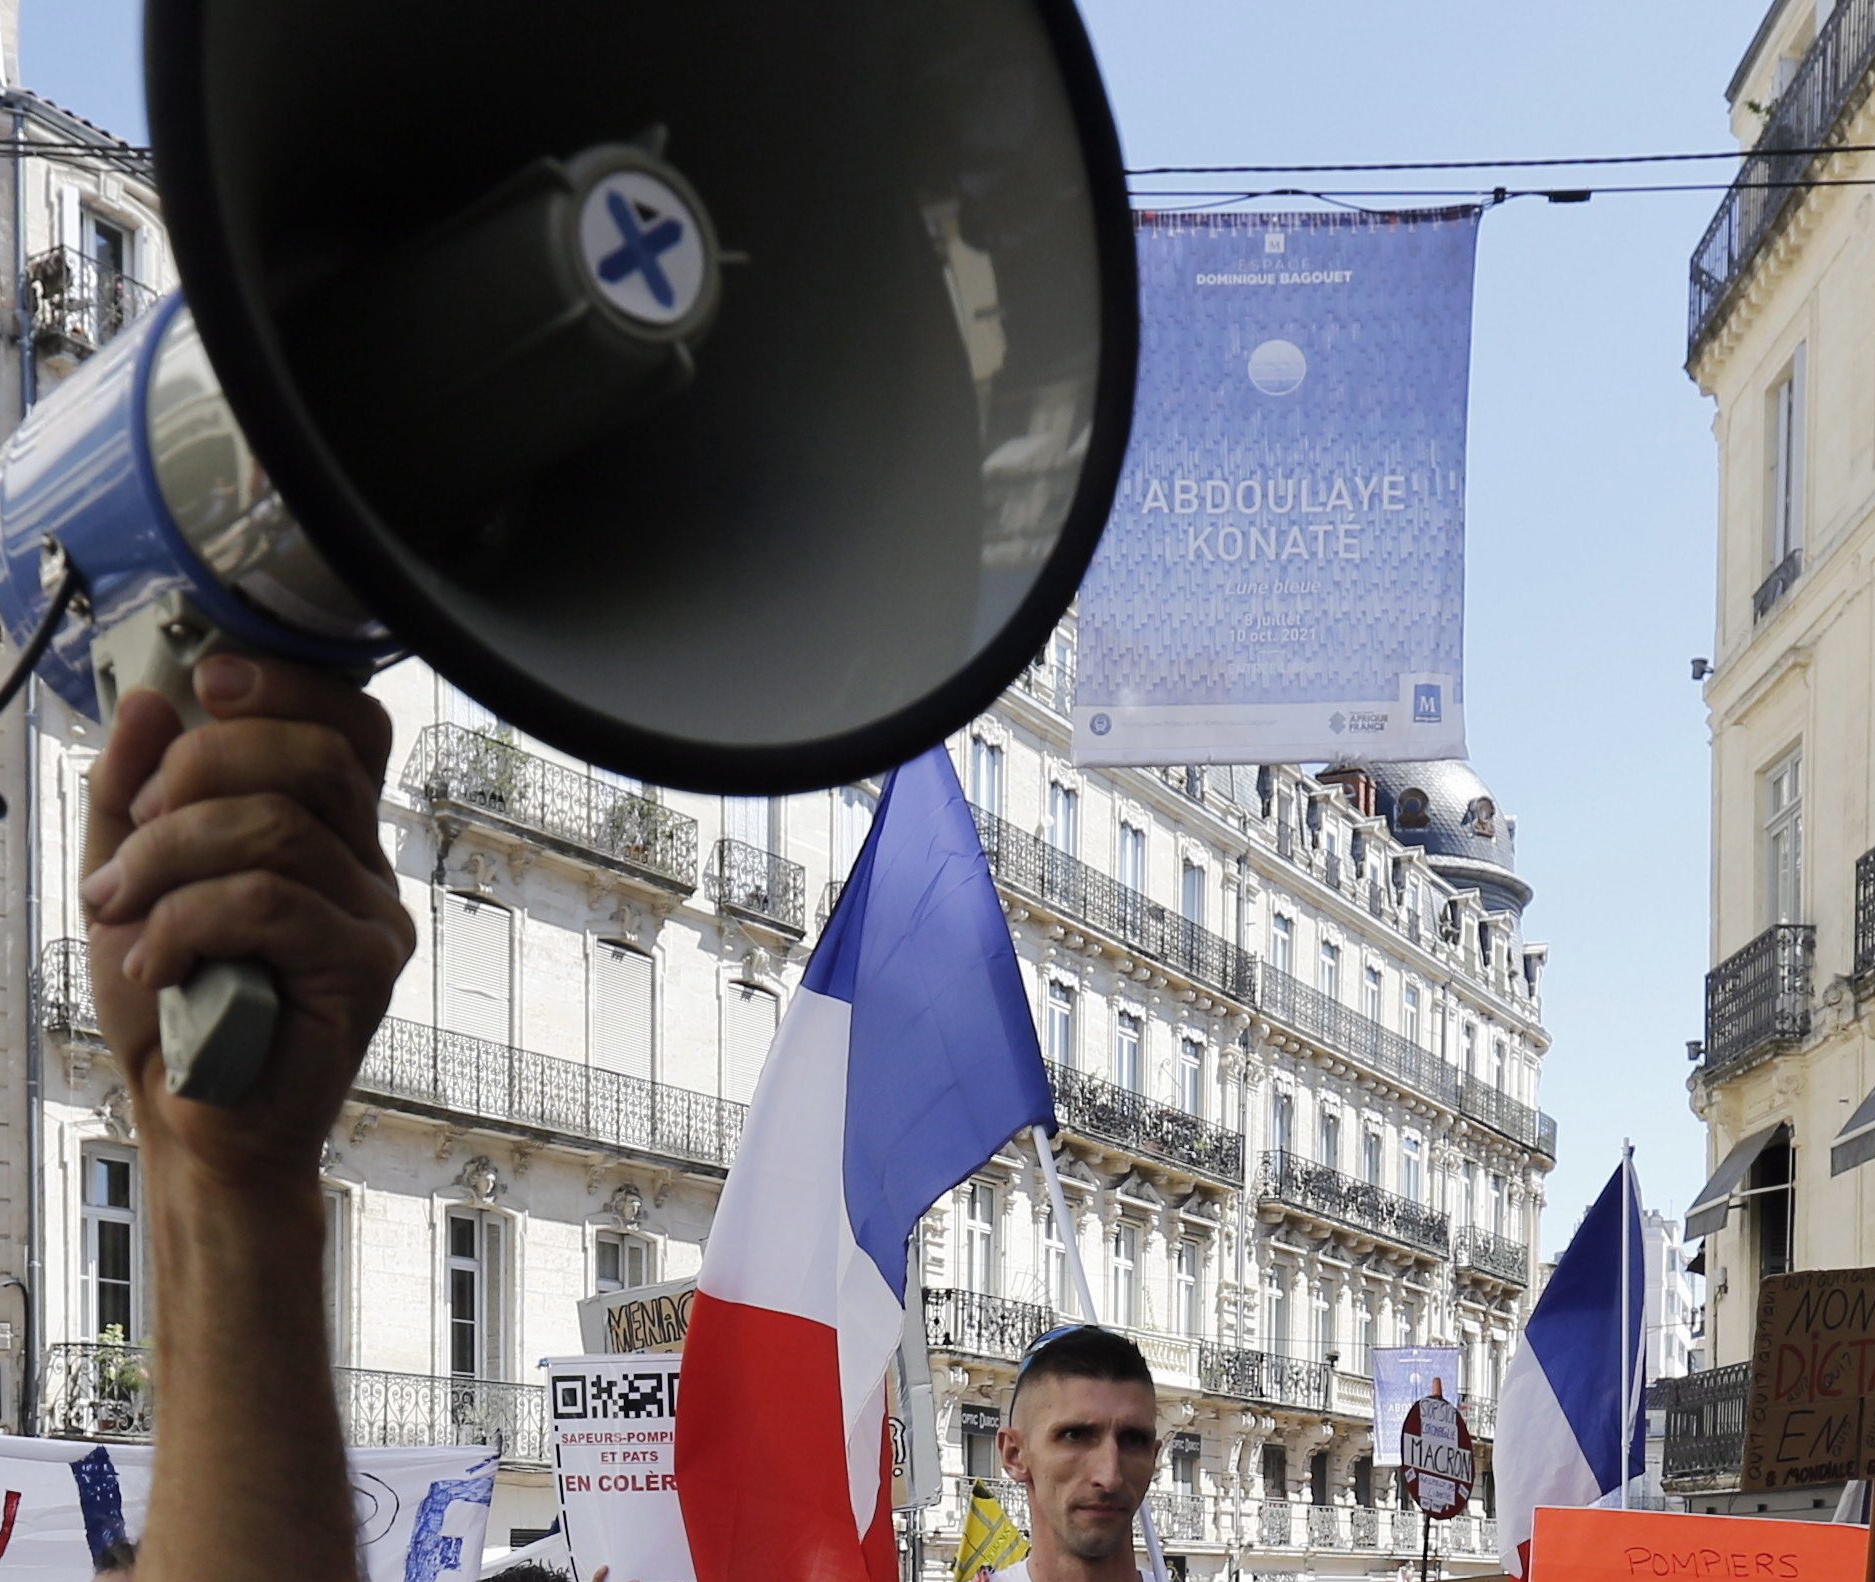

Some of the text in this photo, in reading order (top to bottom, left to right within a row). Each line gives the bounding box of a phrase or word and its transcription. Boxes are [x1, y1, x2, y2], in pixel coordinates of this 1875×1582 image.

[1196, 270, 1353, 285] DOMINIQUE BAGOUET
[1141, 475, 1407, 515] ABDOULAYE
[1187, 514, 1362, 562] KONATÉ
[1225, 578, 1322, 595] Lune bleue
[1255, 613, 1302, 629] juillet
[1229, 627, 1317, 642] 10 oct. 2021
[1776, 1409, 1850, 1463] EN
[601, 1451, 659, 1462] ET PATS
[1411, 1437, 1472, 1481] MACRON
[565, 1475, 591, 1492] EN
[1625, 1546, 1800, 1579] POMPIERS
